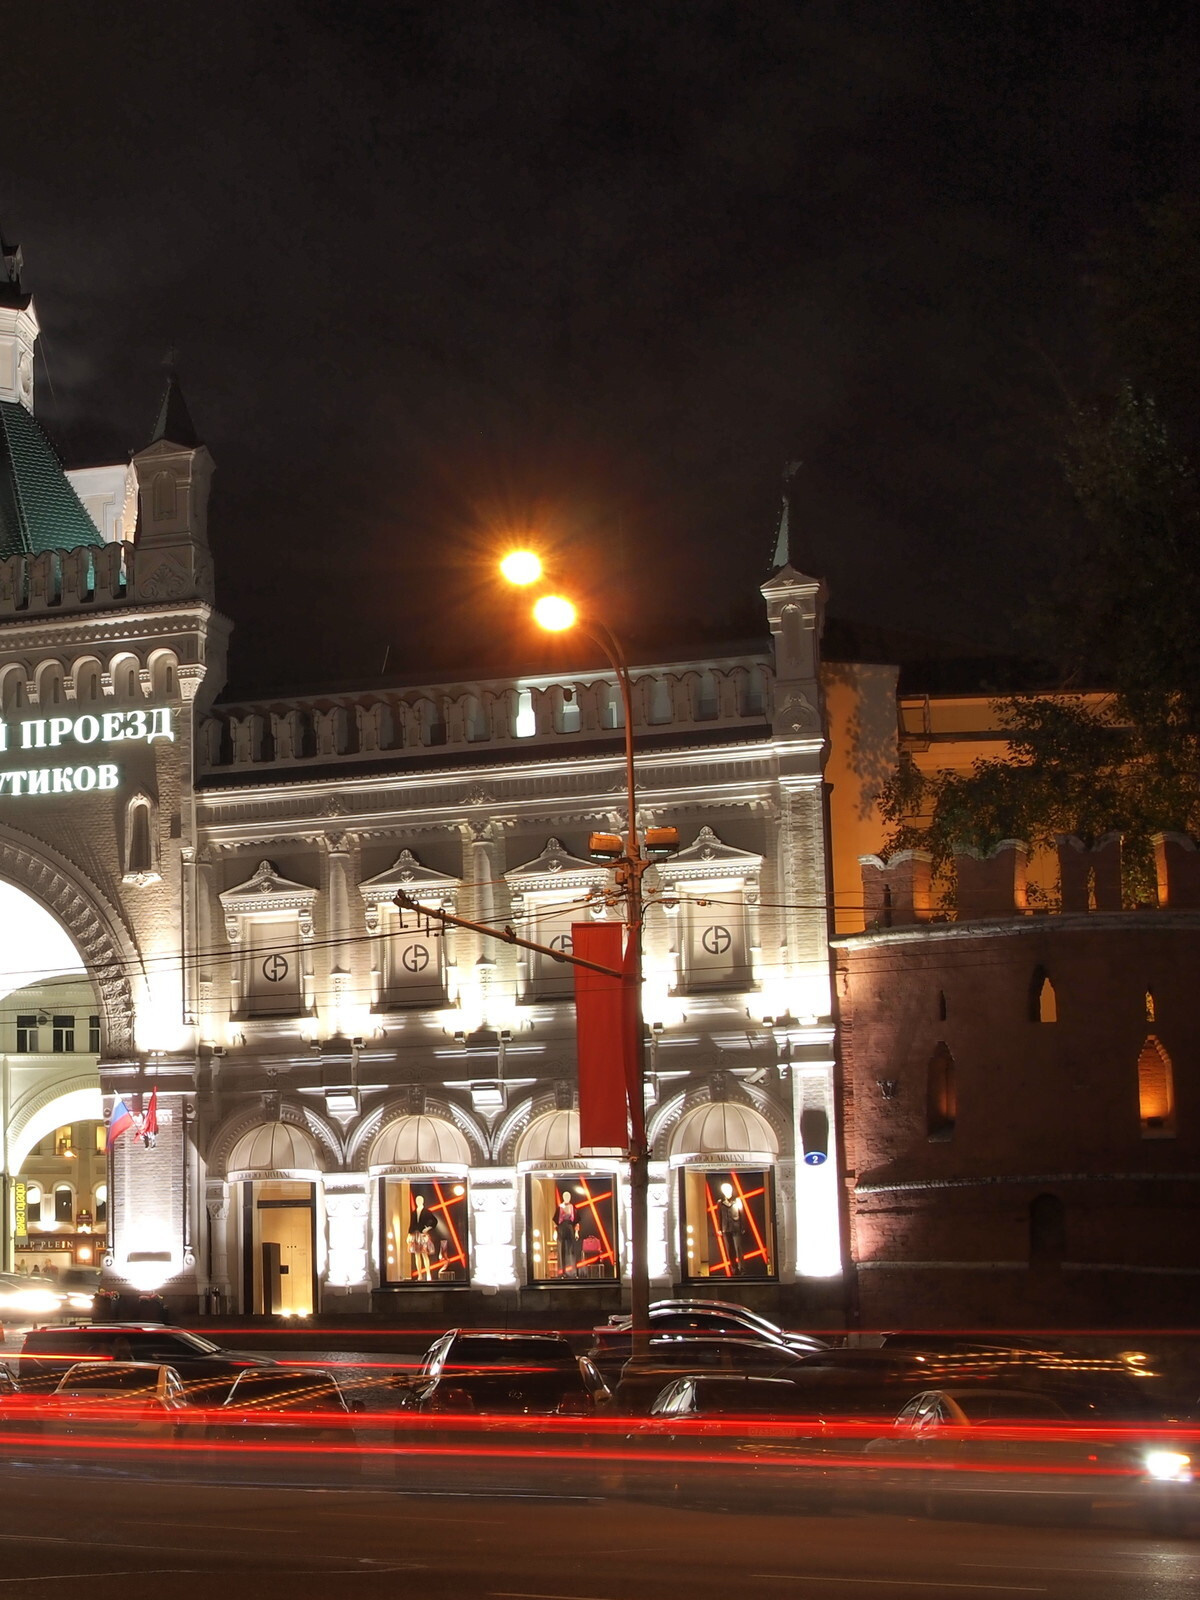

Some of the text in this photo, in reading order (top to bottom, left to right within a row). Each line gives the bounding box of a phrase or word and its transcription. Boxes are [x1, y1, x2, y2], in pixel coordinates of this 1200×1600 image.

[20, 707, 175, 749] ПРОЕЗД
[812, 1155, 819, 1164] 2
[16, 1183, 26, 1210] roberto
[16, 1211, 27, 1236] cavalli
